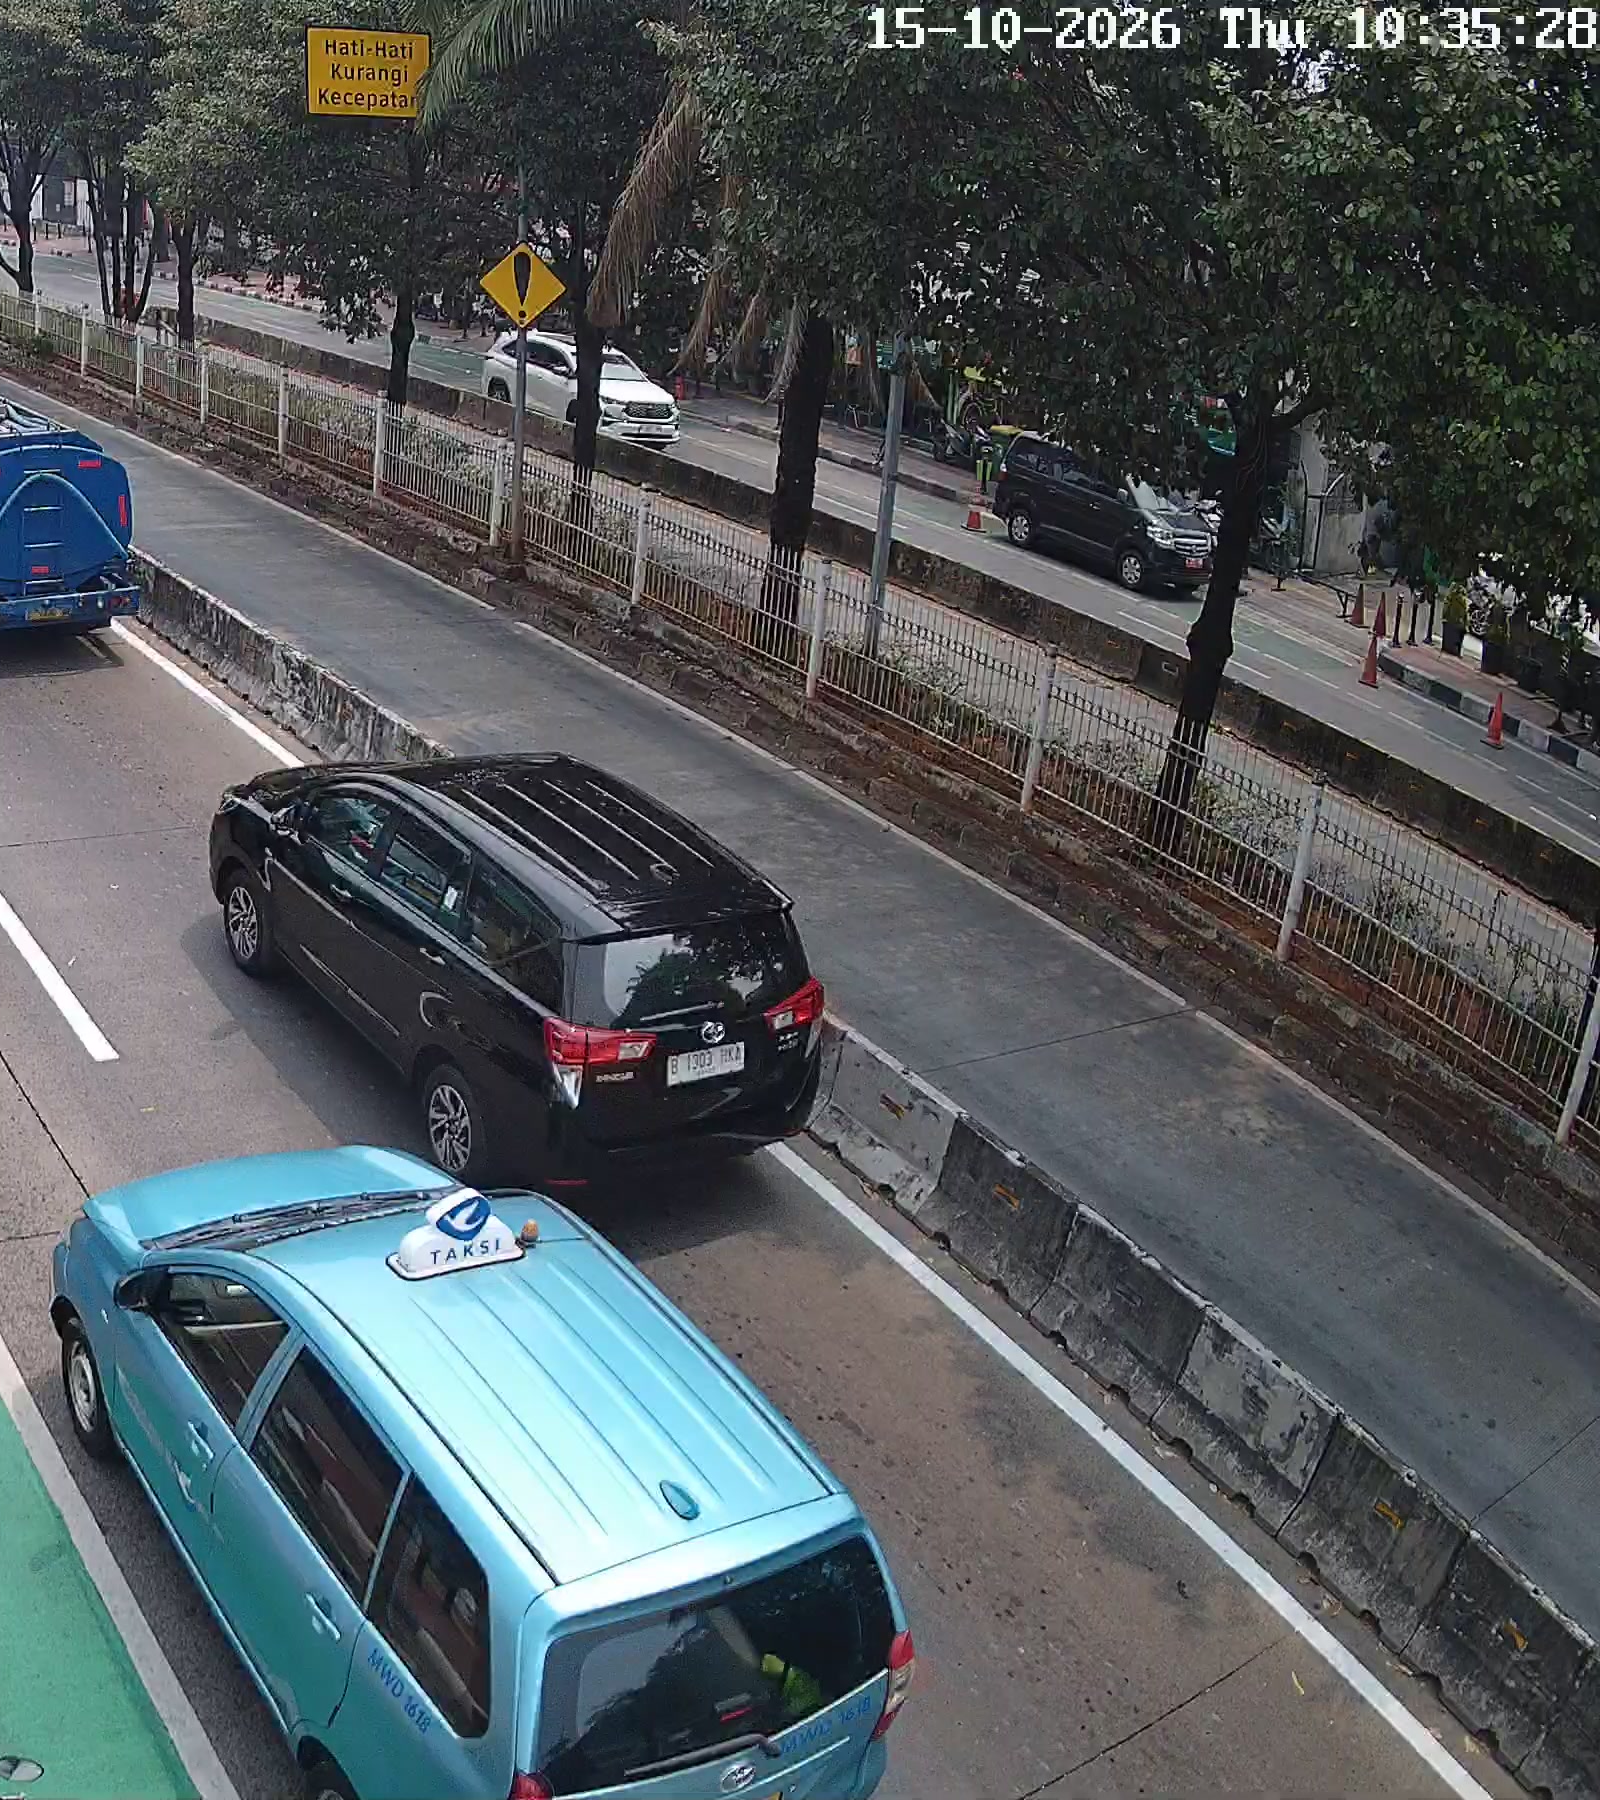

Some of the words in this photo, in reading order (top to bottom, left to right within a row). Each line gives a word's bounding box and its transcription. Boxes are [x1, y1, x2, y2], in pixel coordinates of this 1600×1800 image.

[325, 39, 413, 59] Hati-Hati
[331, 63, 408, 87] Kurangi
[430, 1237, 500, 1265] TAKSI
[367, 1646, 405, 1698] MWD
